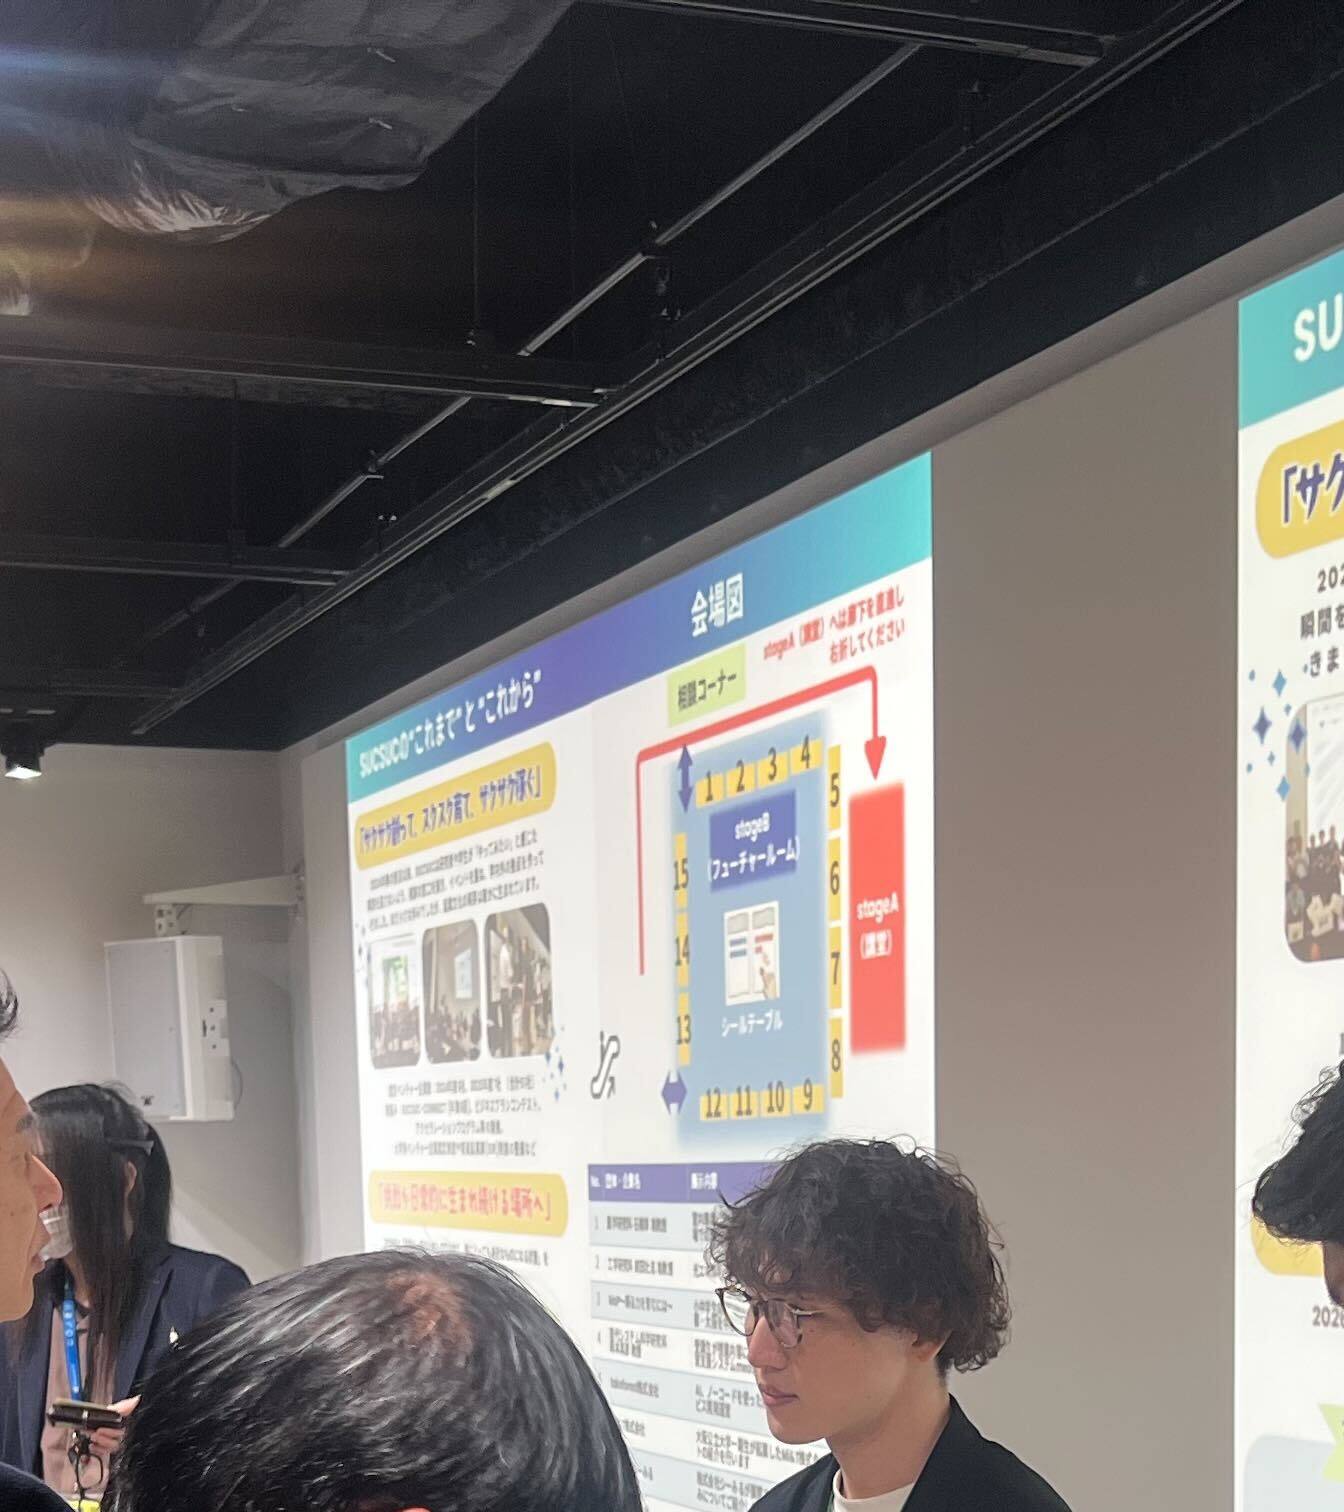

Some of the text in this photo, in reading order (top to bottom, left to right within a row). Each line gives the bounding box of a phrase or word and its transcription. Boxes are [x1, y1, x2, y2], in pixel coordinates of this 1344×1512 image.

[691, 572, 744, 637] 会場図
[768, 747, 777, 781] 3
[800, 735, 810, 769] 4
[705, 769, 714, 802] 1
[736, 760, 745, 792] 2
[830, 772, 840, 808] 5
[674, 858, 689, 891] 15
[830, 861, 840, 895] 6
[831, 951, 840, 985] 7
[677, 1014, 692, 1045] 13
[831, 1039, 841, 1072] 8
[706, 1087, 722, 1118] 12
[736, 1085, 753, 1117] 11
[767, 1080, 785, 1113] 10
[803, 1077, 813, 1111] 9
